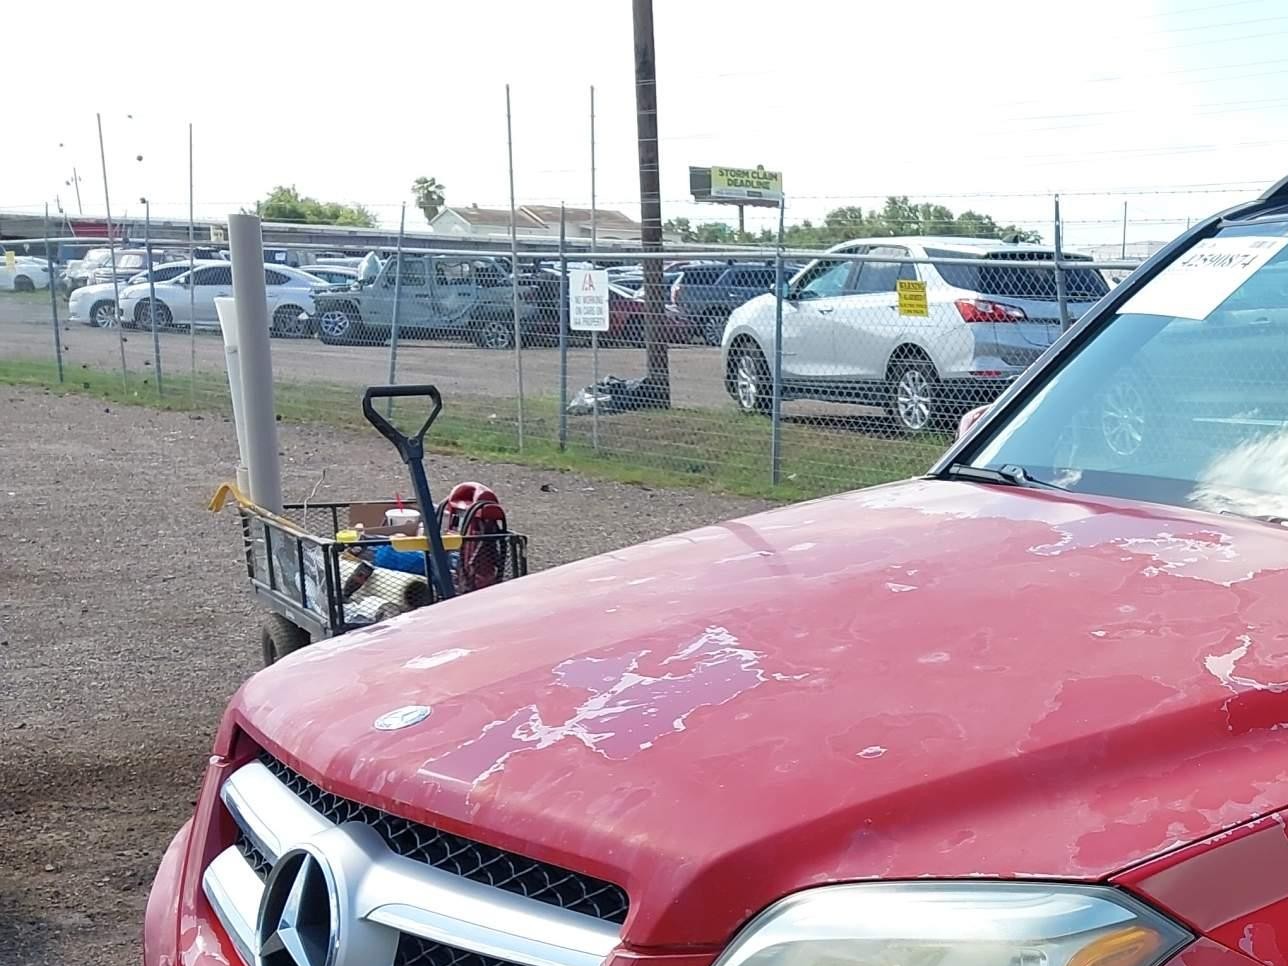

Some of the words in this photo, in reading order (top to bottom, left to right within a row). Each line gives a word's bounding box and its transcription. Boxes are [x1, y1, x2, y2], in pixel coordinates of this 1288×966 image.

[719, 168, 749, 178] STORM
[751, 170, 778, 181] CLAIM
[728, 179, 770, 190] DEADLINE
